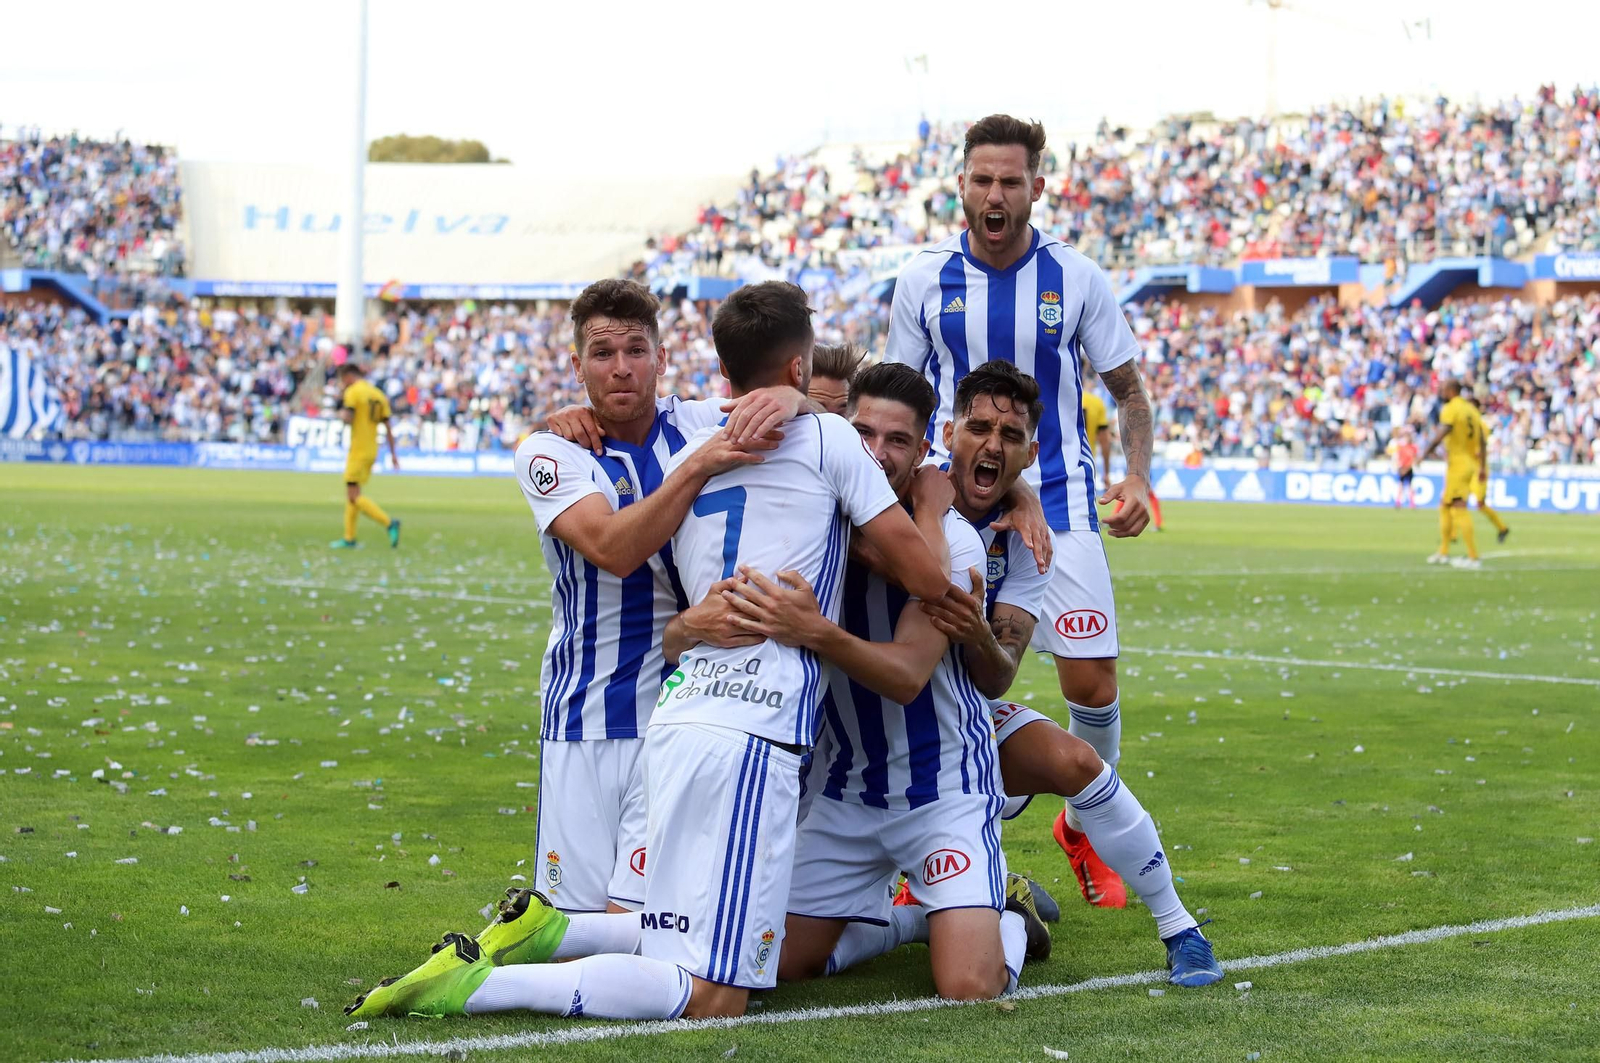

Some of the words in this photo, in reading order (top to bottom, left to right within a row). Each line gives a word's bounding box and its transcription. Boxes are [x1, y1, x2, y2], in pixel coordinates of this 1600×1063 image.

[243, 204, 510, 234] Huelva
[944, 304, 968, 314] adidas
[693, 486, 747, 579] 7
[1063, 616, 1100, 633] KIA
[927, 855, 960, 881] KIA
[641, 912, 690, 933] MEO
